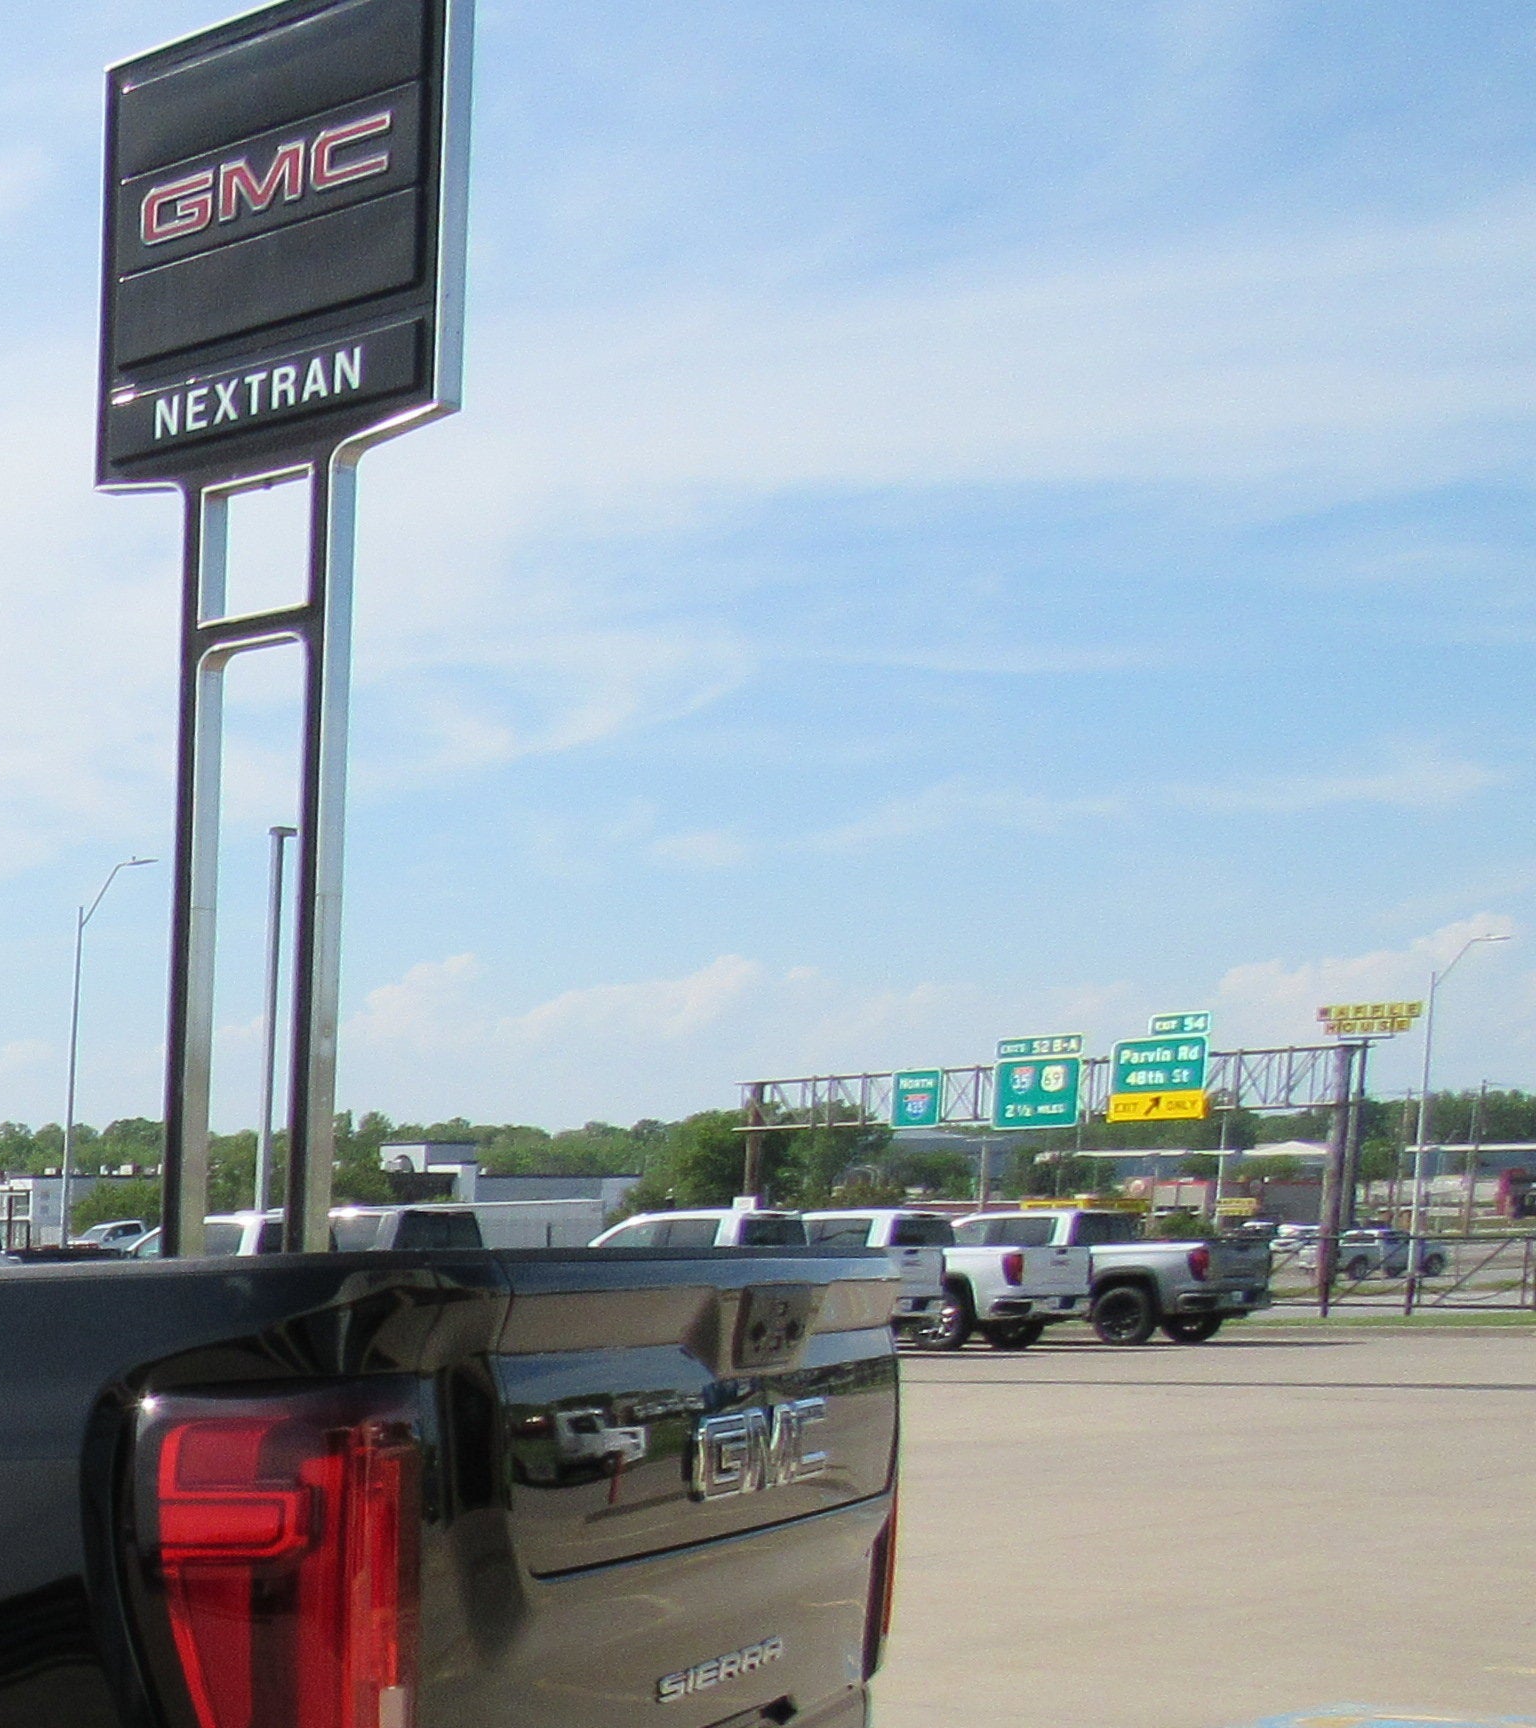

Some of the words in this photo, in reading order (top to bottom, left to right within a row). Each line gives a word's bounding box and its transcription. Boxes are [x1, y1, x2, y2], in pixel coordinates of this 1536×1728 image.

[140, 111, 392, 246] GMC
[154, 345, 362, 440] NEXTRAN
[1155, 1020, 1178, 1031] EXIT
[1183, 1016, 1206, 1031] 54
[1326, 1019, 1410, 1033] HOUSE
[1031, 1040, 1050, 1053] 52
[1119, 1047, 1173, 1065] Parvin
[1177, 1045, 1200, 1061] Rd
[899, 1077, 934, 1090] NORTH
[1011, 1074, 1030, 1090] 35
[1044, 1071, 1064, 1088] 69
[1125, 1069, 1165, 1085] 48th
[1170, 1068, 1191, 1084] St
[1004, 1105, 1016, 1118] 2
[697, 1397, 827, 1501] GMC
[656, 1635, 782, 1703] SIERRA
